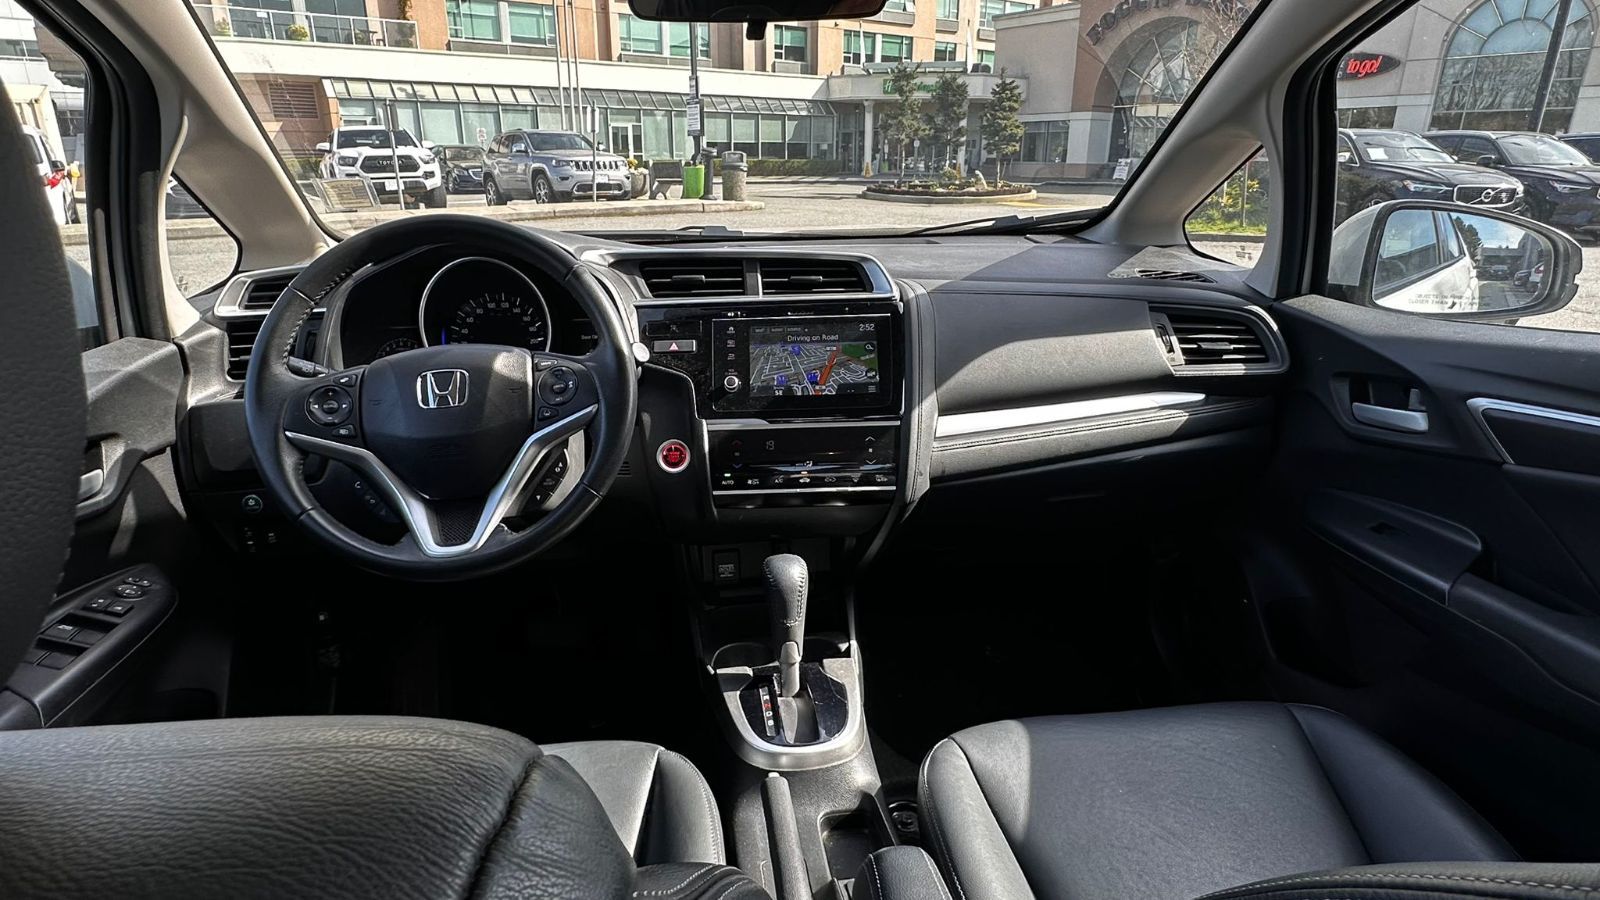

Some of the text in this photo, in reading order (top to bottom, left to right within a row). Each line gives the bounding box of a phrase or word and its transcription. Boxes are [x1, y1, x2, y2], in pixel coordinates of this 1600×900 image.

[1346, 58, 1360, 73] to
[1358, 55, 1383, 78] go!
[859, 323, 875, 331] 2:52
[822, 333, 839, 341] Road
